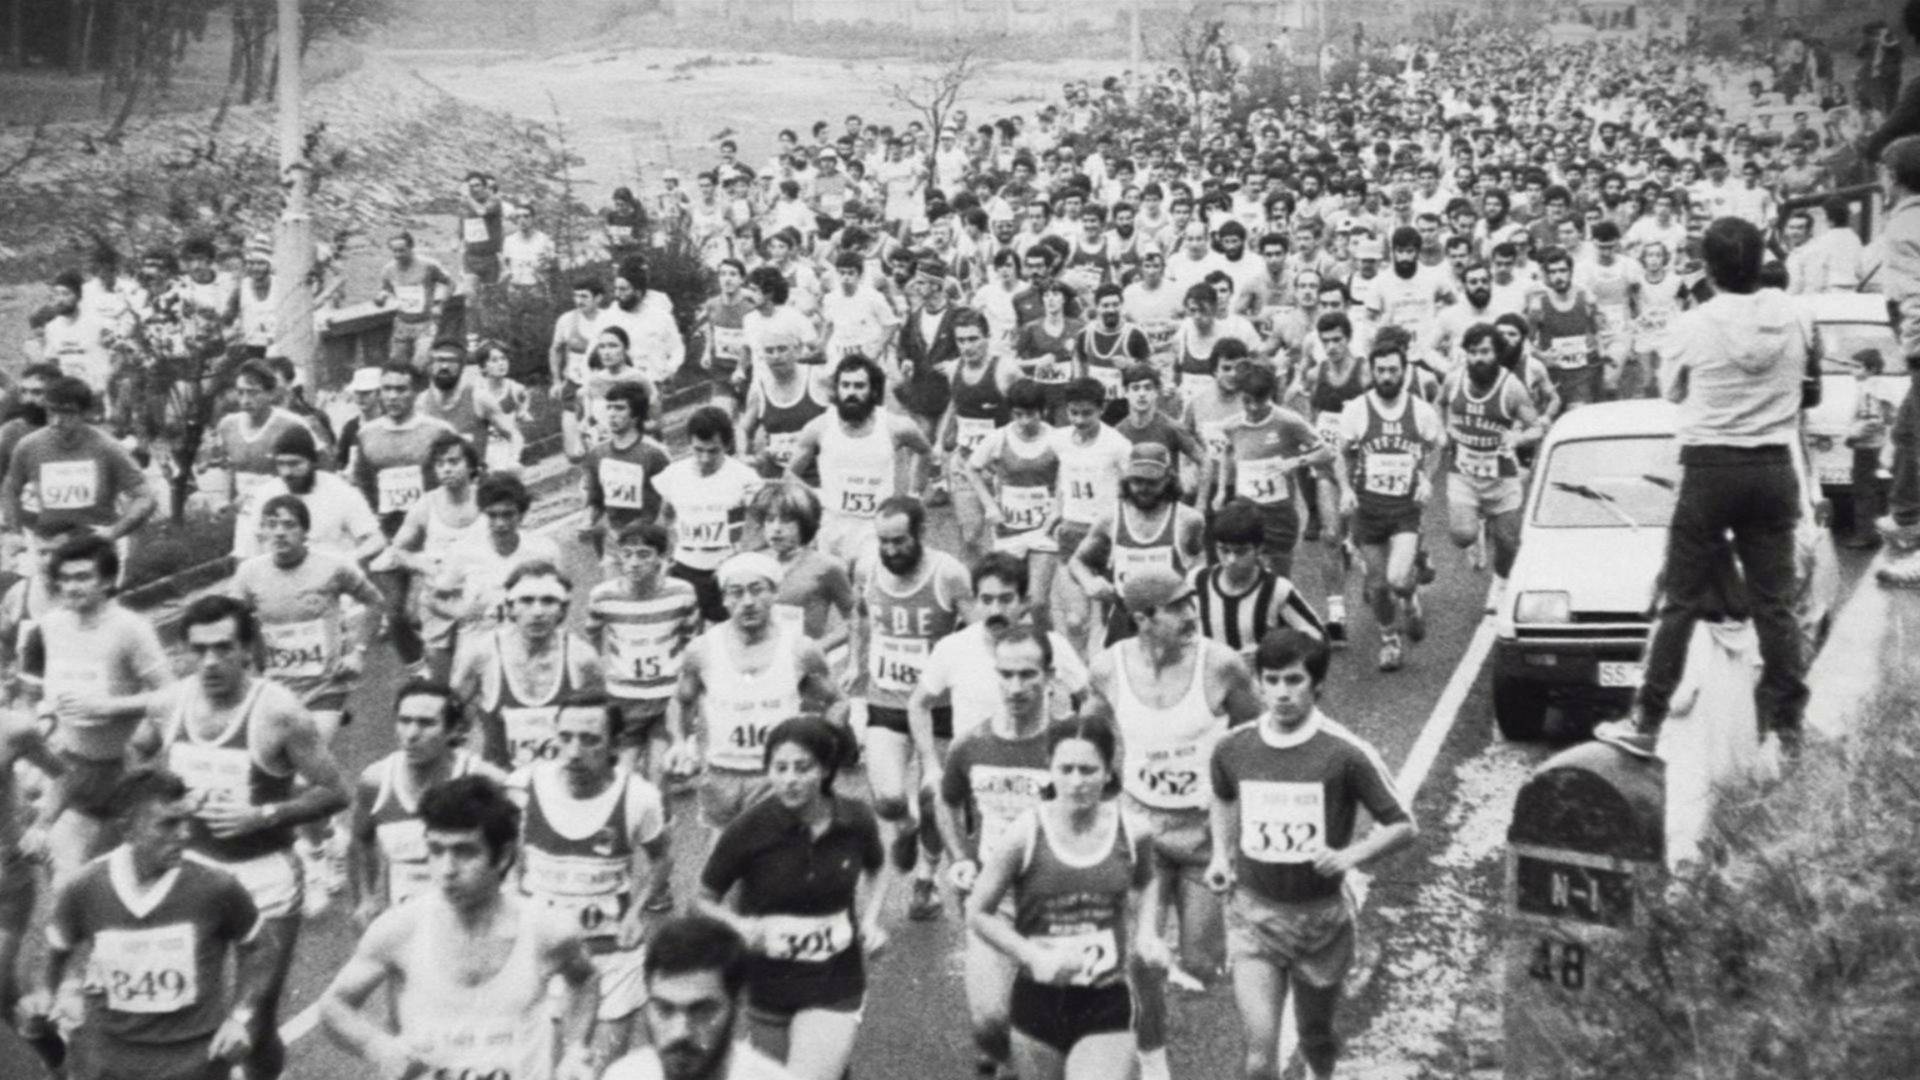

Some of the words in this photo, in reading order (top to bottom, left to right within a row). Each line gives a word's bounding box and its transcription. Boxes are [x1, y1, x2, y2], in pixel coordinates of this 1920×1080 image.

[842, 491, 876, 513] 153
[635, 656, 661, 679] 15
[1602, 664, 1627, 686] SS
[1249, 821, 1318, 853] 332
